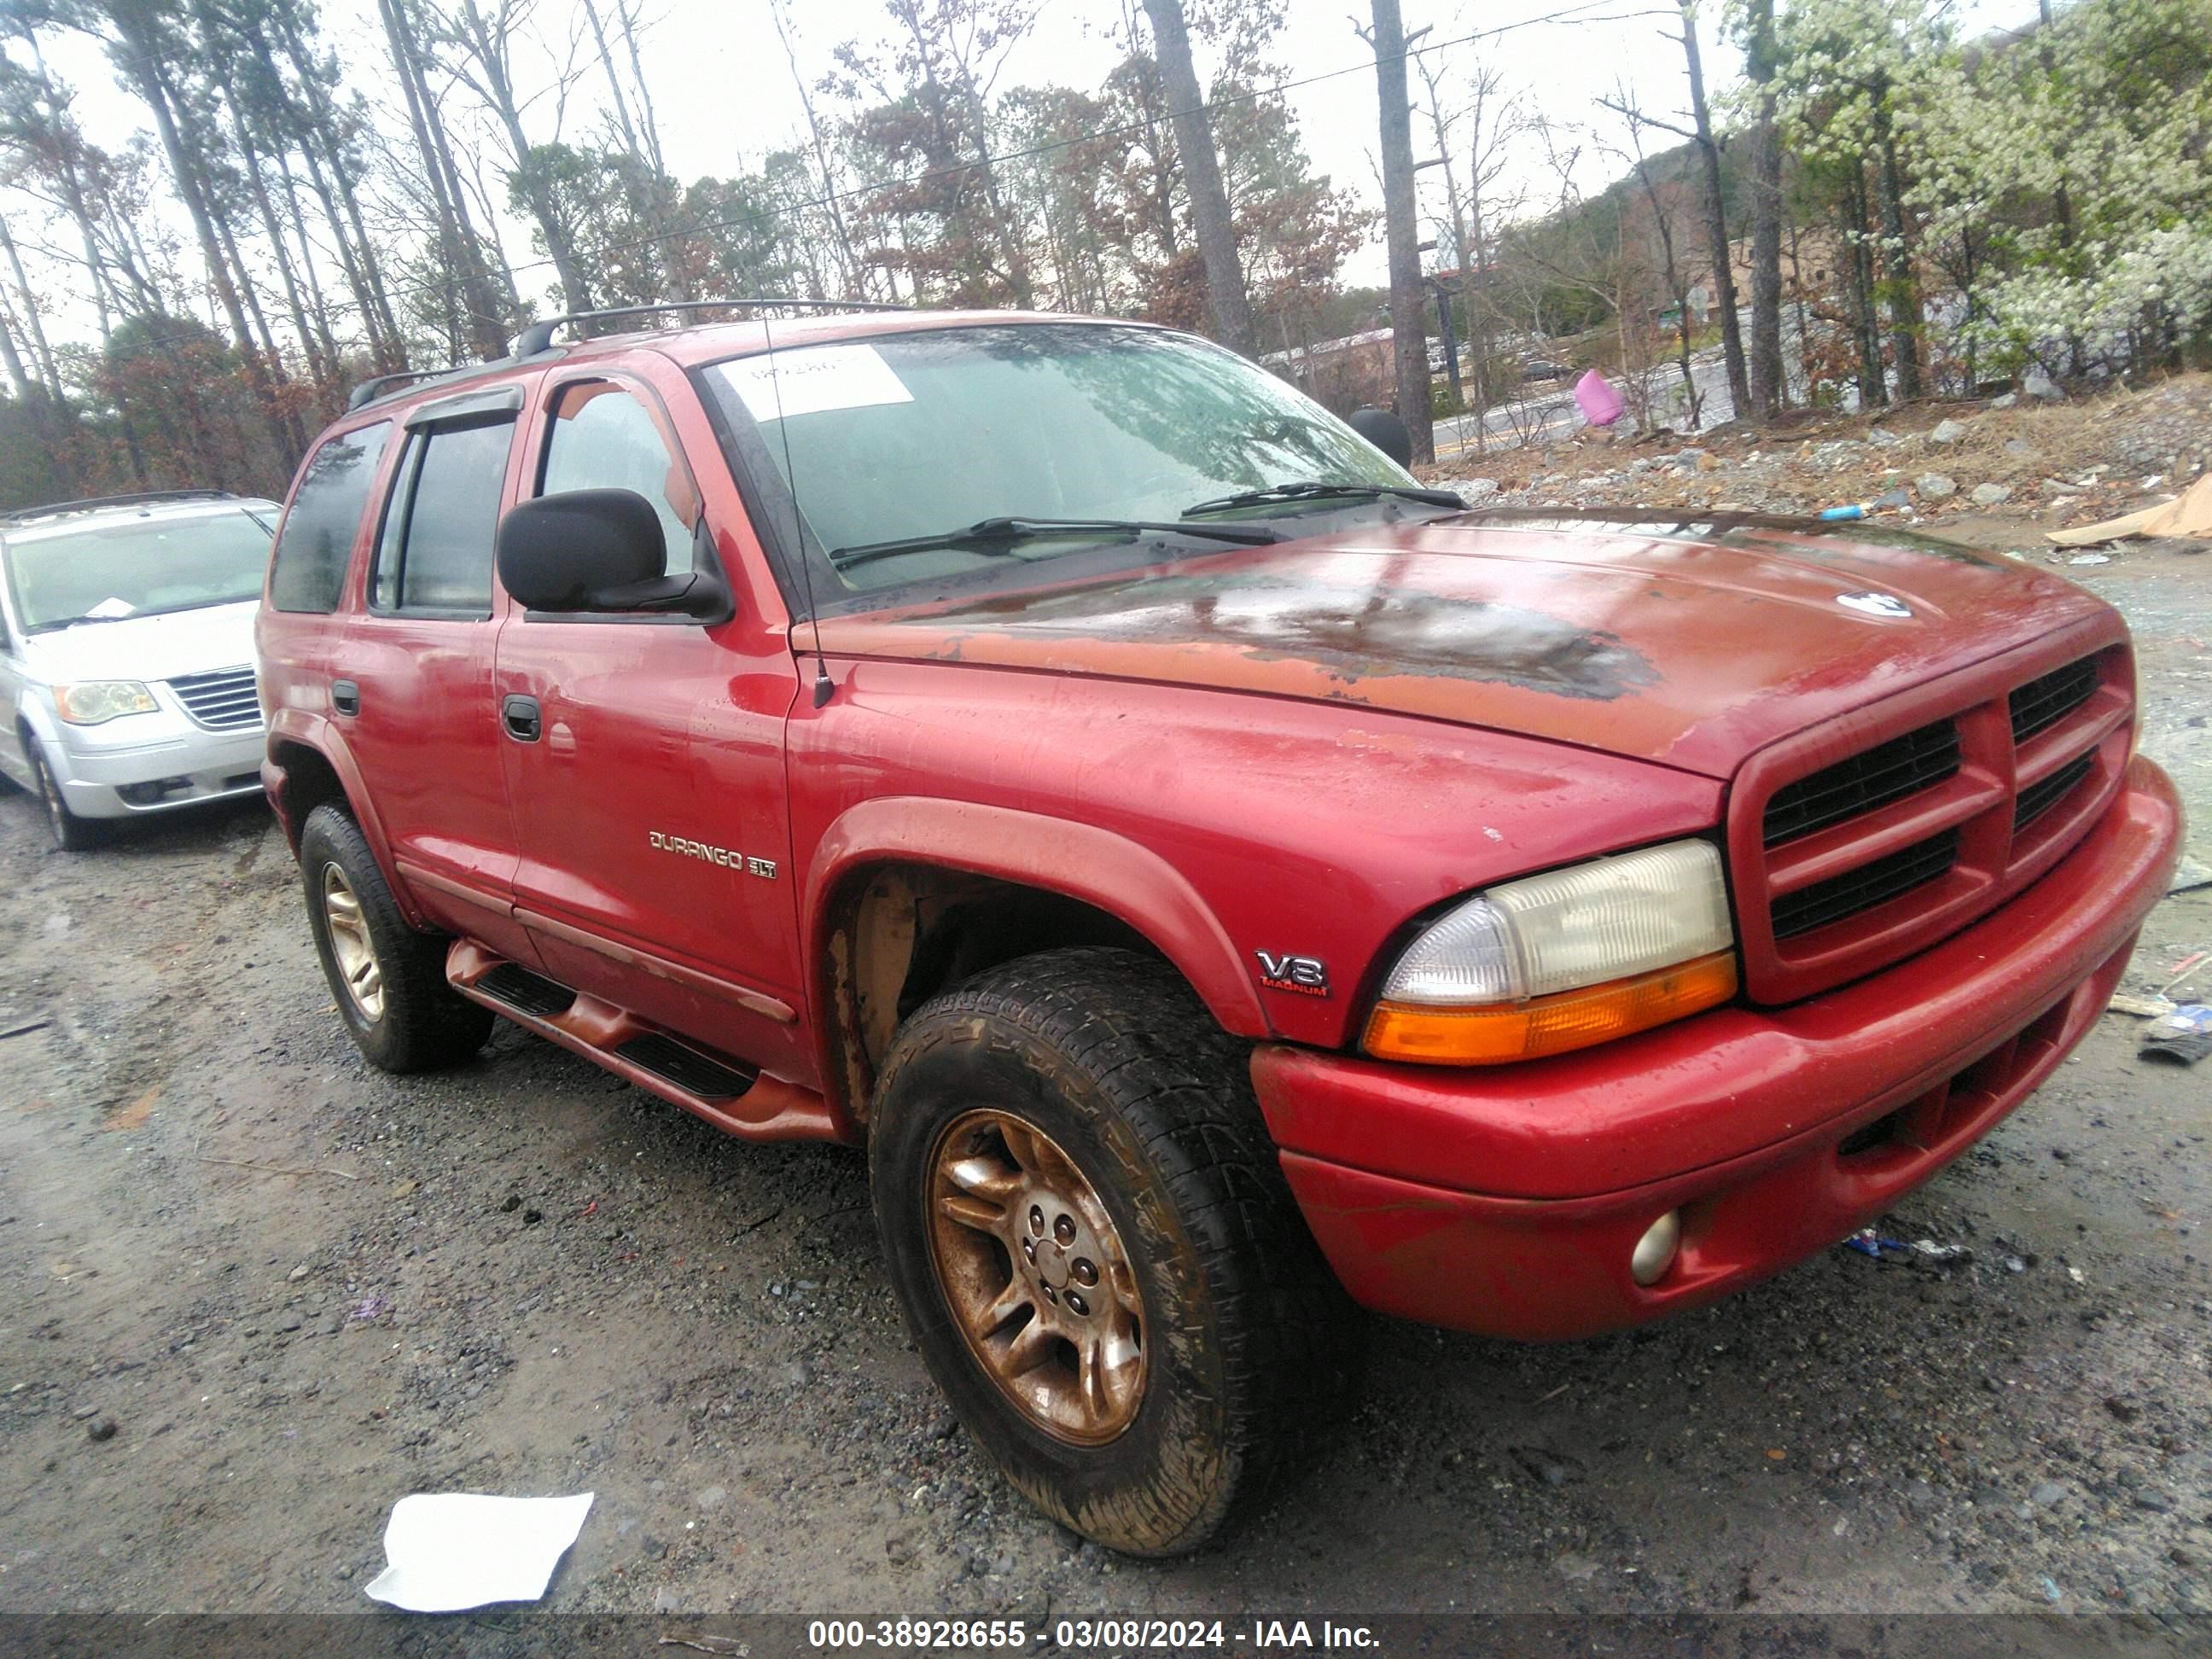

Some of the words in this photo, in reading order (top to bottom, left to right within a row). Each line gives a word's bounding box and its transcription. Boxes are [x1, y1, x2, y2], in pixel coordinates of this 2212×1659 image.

[649, 831, 743, 870] DURANGO
[748, 857, 777, 879] SLT
[1254, 949, 1324, 986] V8
[1260, 976, 1326, 996] MAGNUM
